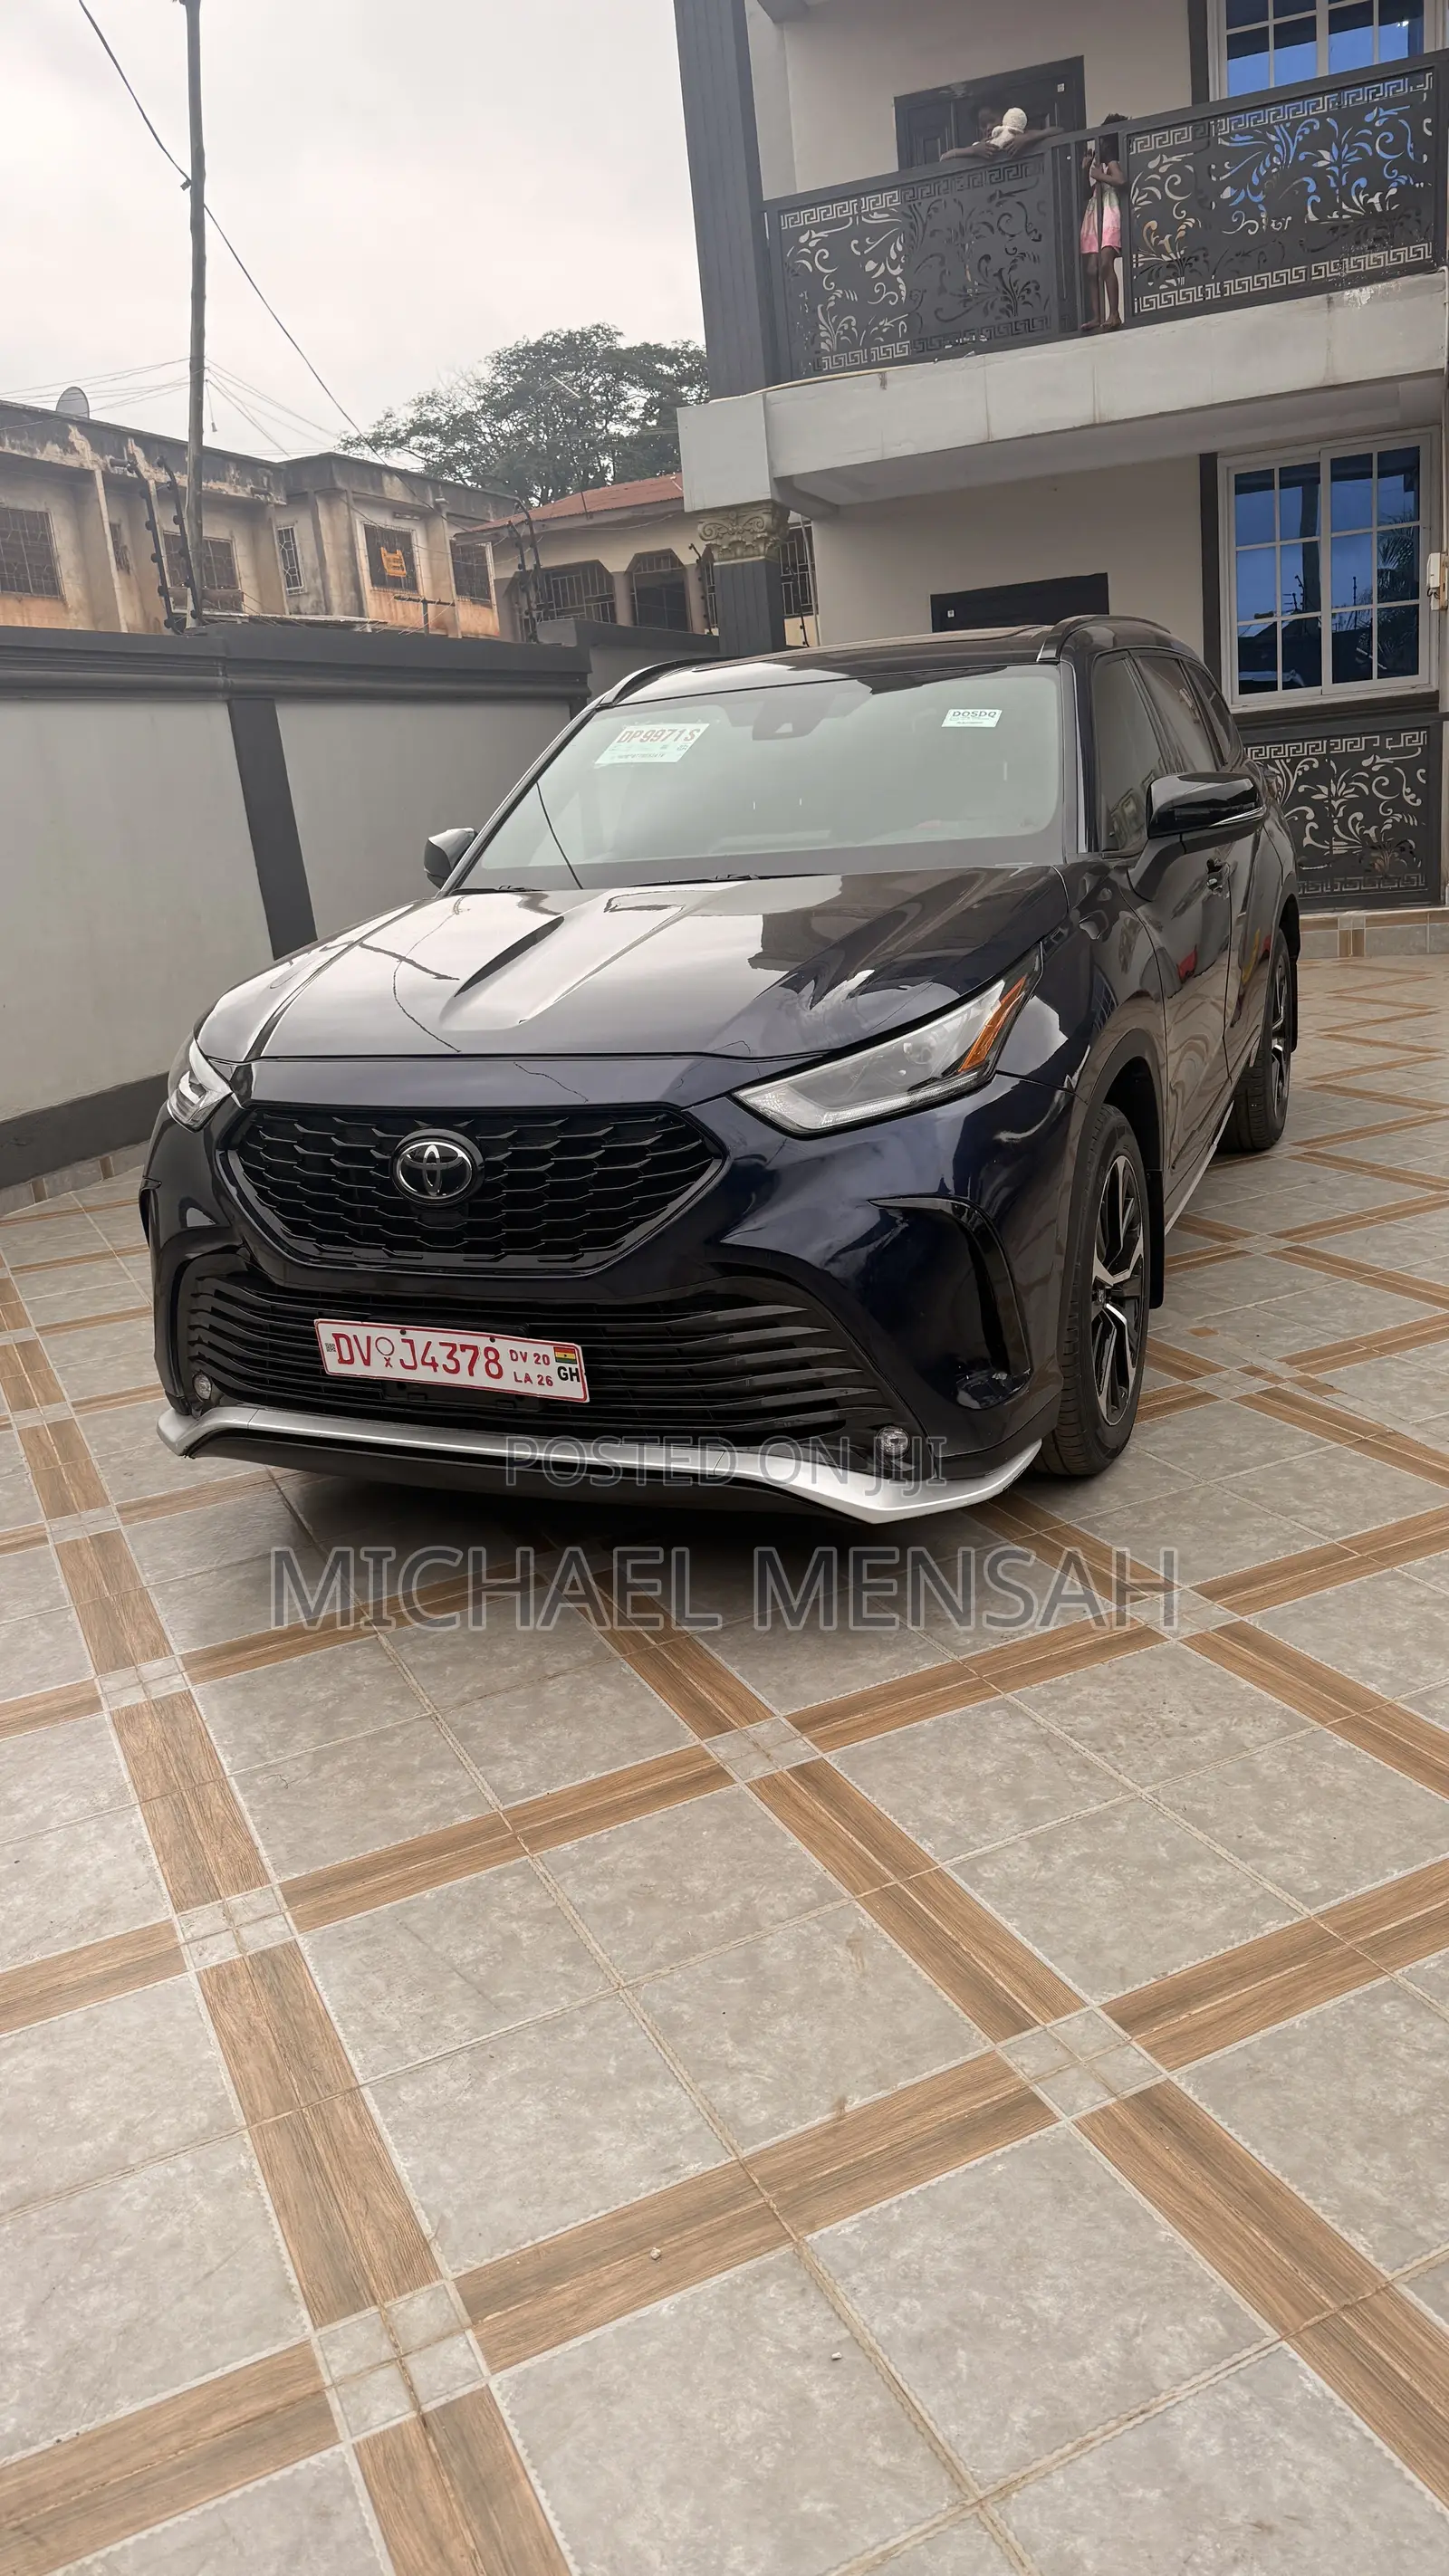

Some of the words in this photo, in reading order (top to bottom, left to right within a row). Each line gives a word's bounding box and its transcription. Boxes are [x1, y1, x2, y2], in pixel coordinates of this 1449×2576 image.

[331, 1333, 371, 1366] DV
[399, 1338, 504, 1380] J4378
[509, 1349, 528, 1363] DV
[533, 1353, 551, 1365] 20
[513, 1371, 533, 1384] LA
[536, 1374, 554, 1387] 26
[557, 1365, 581, 1383] GH
